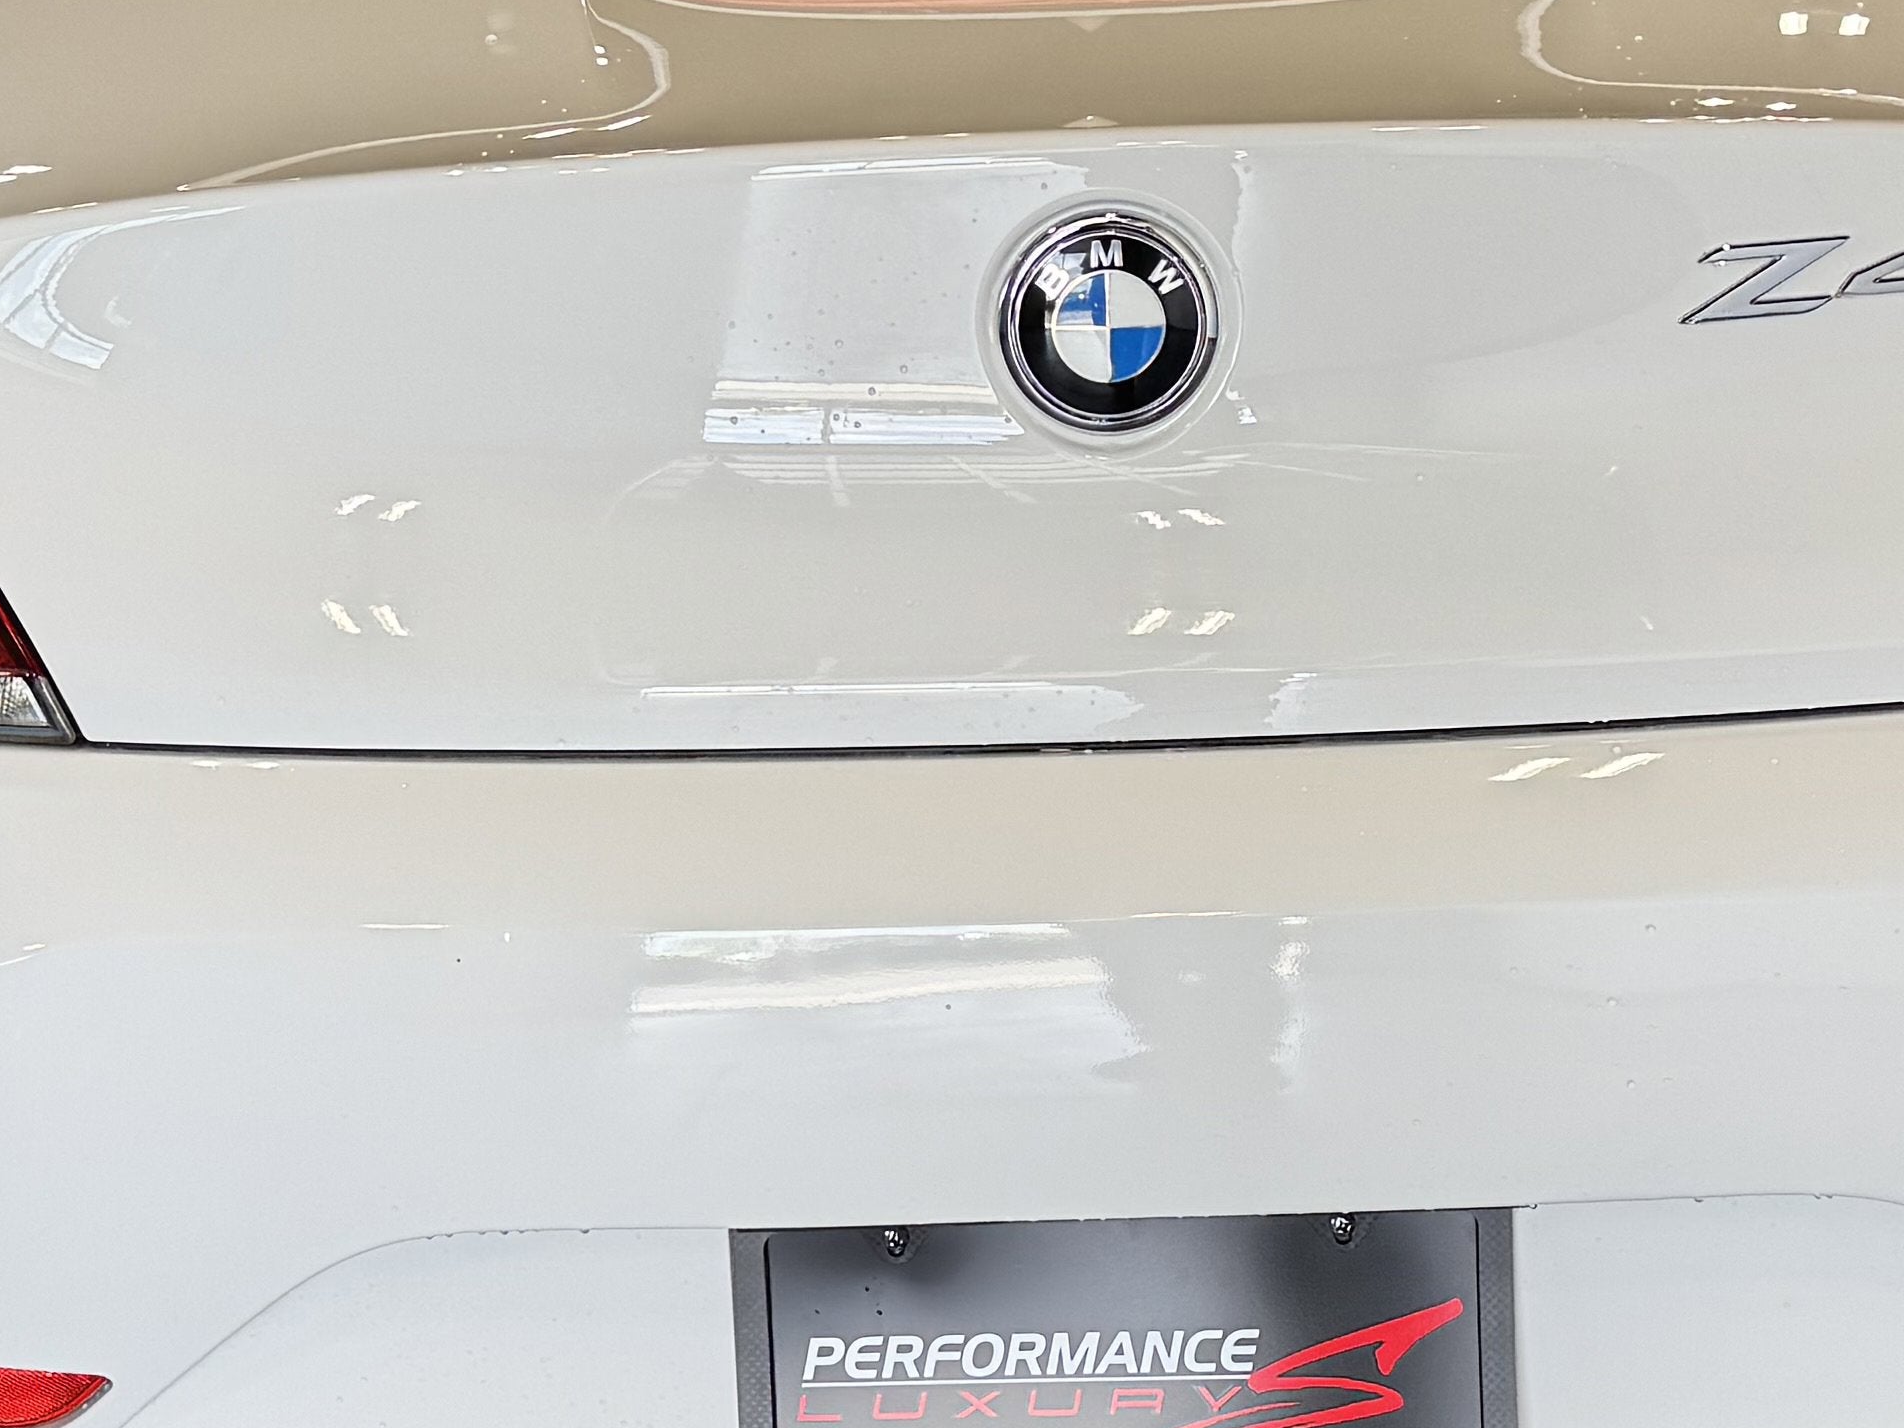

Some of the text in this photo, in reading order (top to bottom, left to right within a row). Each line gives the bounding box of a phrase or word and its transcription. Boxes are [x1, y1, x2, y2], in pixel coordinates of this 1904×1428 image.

[1034, 239, 1184, 301] BMW
[802, 1328, 1260, 1380] PERFORMANCE
[796, 1384, 1243, 1423] LUXURY
